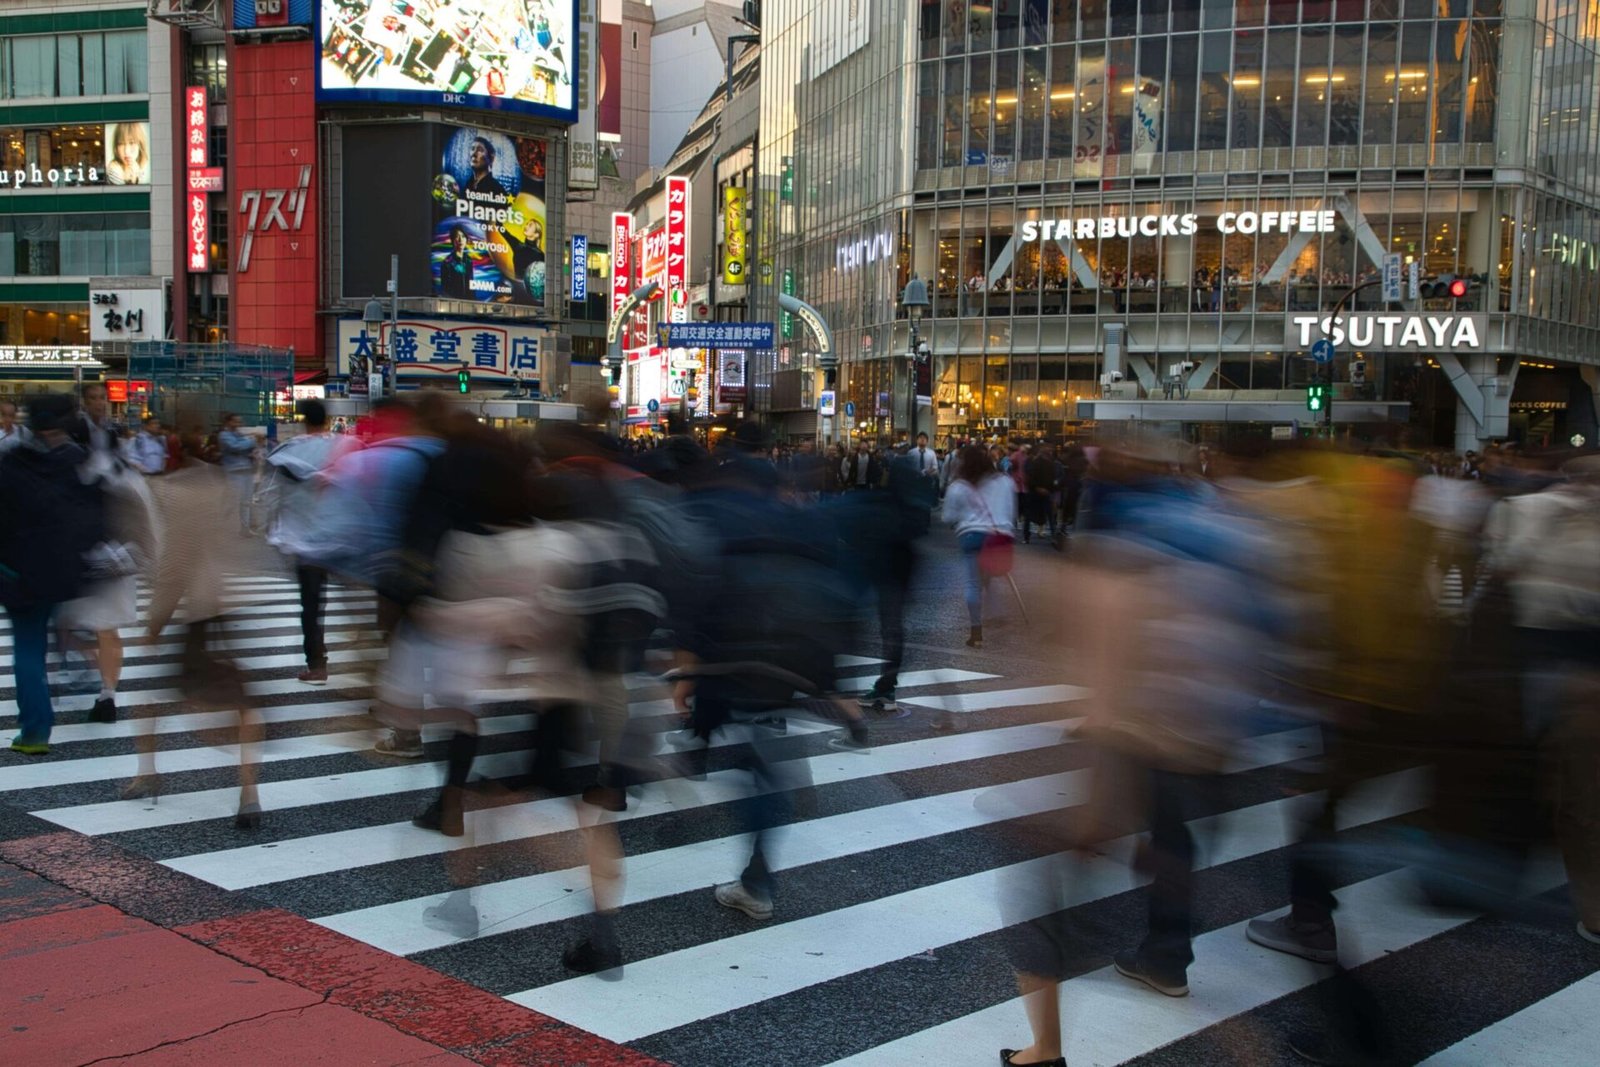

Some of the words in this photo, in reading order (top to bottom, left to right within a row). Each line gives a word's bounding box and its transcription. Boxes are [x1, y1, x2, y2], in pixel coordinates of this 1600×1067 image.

[443, 94, 465, 104] DHC
[465, 188, 507, 204] teamLab
[237, 165, 311, 272] クスリ
[456, 199, 524, 225] Planets
[476, 223, 506, 233] TOKYO
[669, 189, 685, 266] カラオケ
[1022, 213, 1198, 241] STARBUCKS
[1216, 211, 1335, 234] COFFEE
[472, 240, 509, 253] TOYOSU
[729, 262, 740, 272] 4F
[469, 280, 512, 294] DMM.com
[671, 326, 771, 340] 全国交通安全運動実施中
[1293, 316, 1479, 347] TSUTAYA
[350, 328, 538, 369] 大盛堂書店
